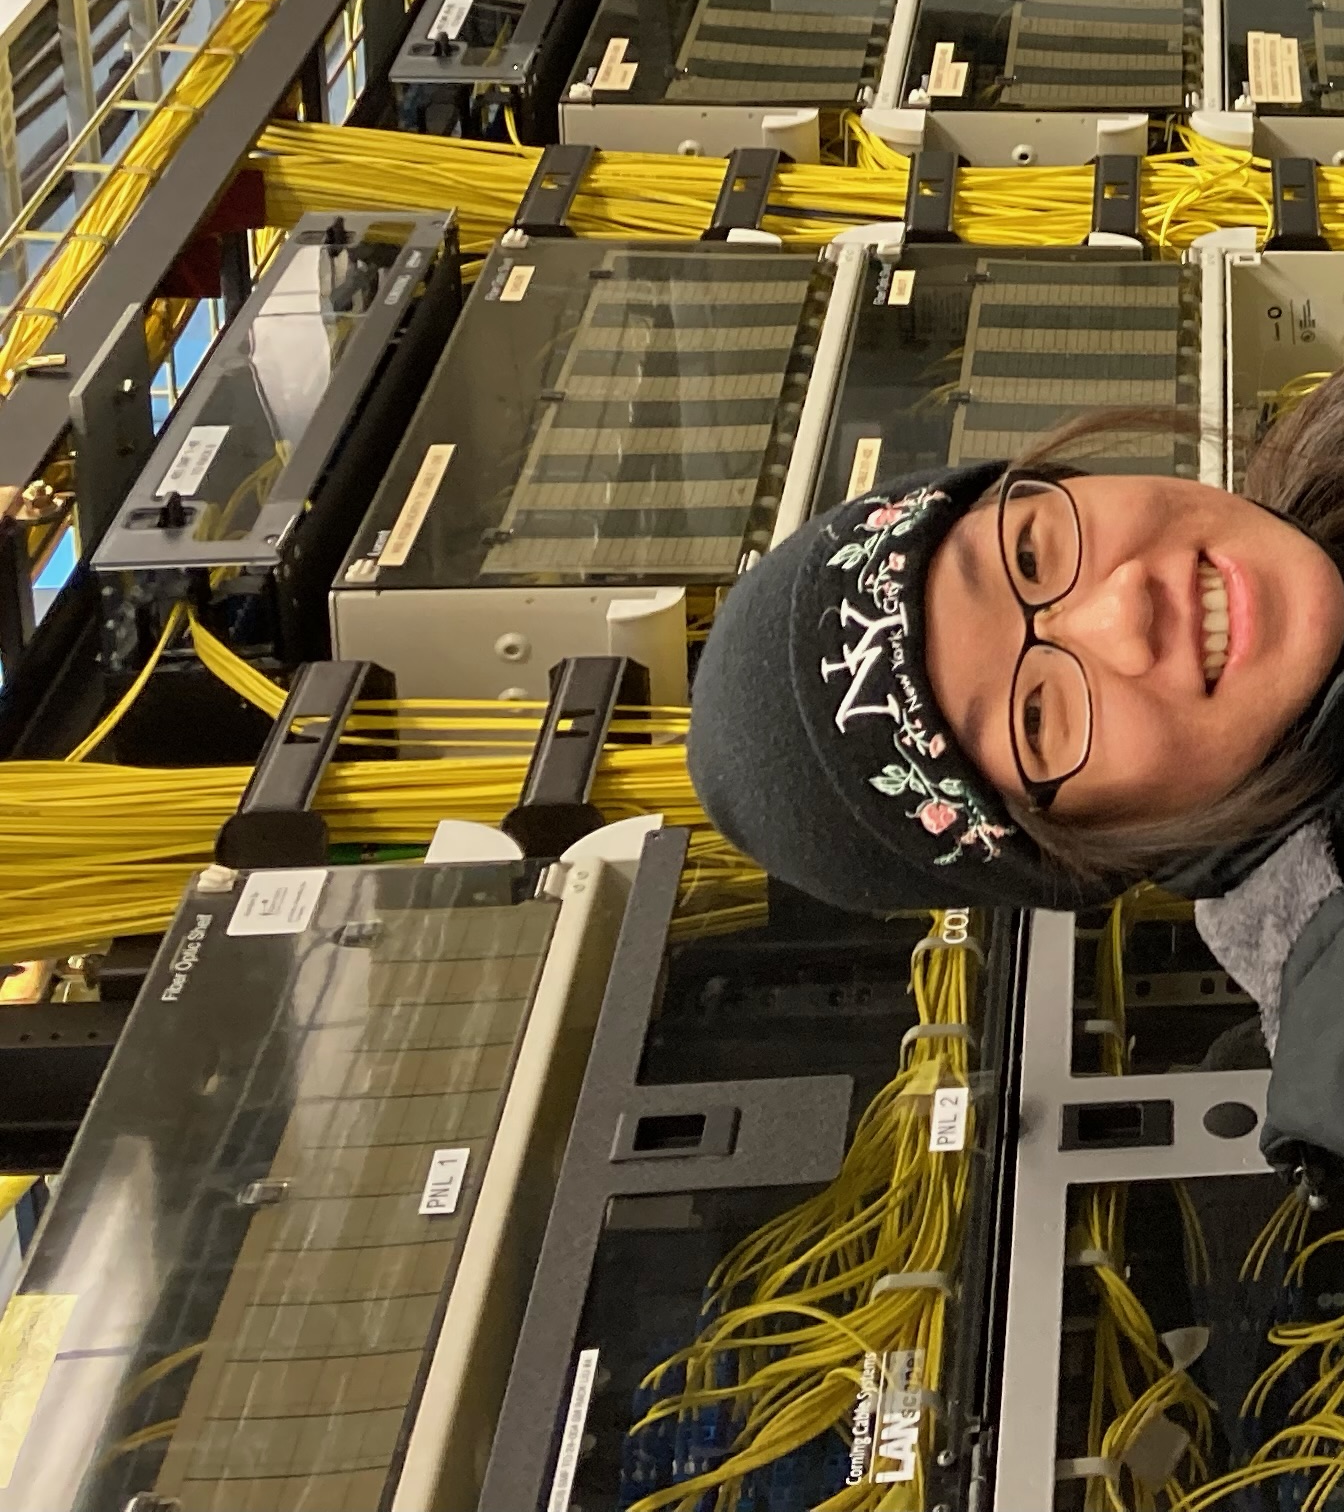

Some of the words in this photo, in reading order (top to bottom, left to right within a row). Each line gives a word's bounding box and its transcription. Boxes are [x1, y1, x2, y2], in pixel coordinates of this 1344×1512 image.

[882, 581, 904, 614] City
[821, 597, 909, 734] NY
[887, 628, 905, 671] York
[895, 673, 923, 713] New
[185, 913, 213, 941] Shelf
[173, 941, 201, 971] Optic
[161, 972, 188, 1002] Fiber
[939, 1096, 959, 1107] 2
[936, 1113, 958, 1146] PNL
[437, 1159, 458, 1167] 1
[426, 1176, 454, 1209] PNL
[856, 1352, 879, 1400] Systems
[852, 1400, 872, 1436] Cable
[846, 1437, 872, 1485] Corning
